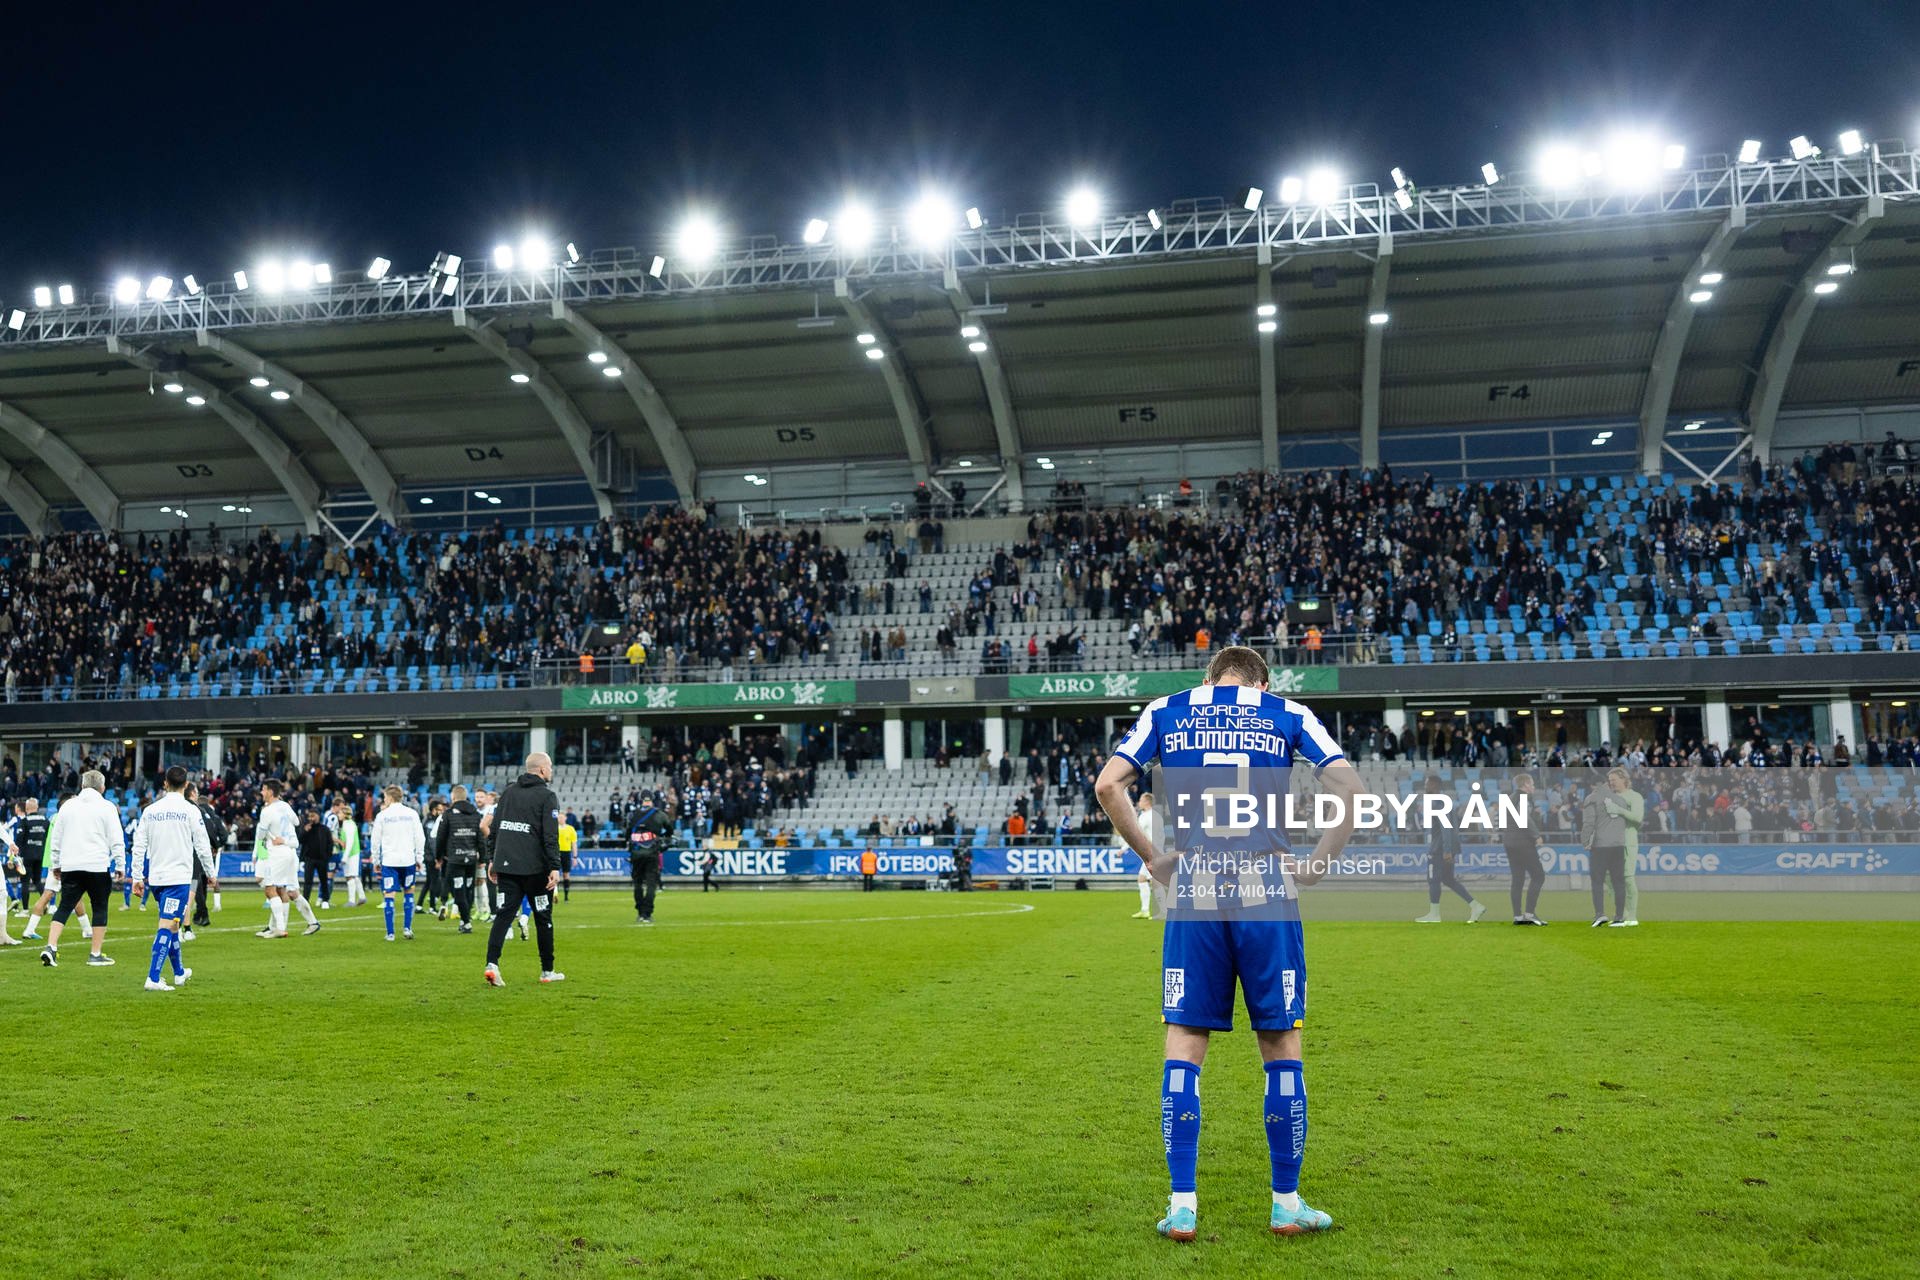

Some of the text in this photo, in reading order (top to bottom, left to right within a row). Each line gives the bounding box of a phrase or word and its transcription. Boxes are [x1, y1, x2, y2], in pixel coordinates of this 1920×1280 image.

[1488, 385, 1531, 401] F4
[1118, 407, 1157, 422] F5
[775, 426, 815, 443] D5
[464, 446, 504, 463] D4
[177, 464, 213, 479] D3
[1191, 705, 1257, 717] NORDIC
[1175, 718, 1274, 730] WELLNESS
[1164, 731, 1286, 758] SALOMONSSON
[1203, 752, 1251, 839] 2
[499, 820, 532, 833] ERNEKE
[830, 851, 957, 873] IFK ÖTEBOR
[1005, 849, 1125, 874] SERNEKE
[1776, 852, 1864, 869] CRAFT
